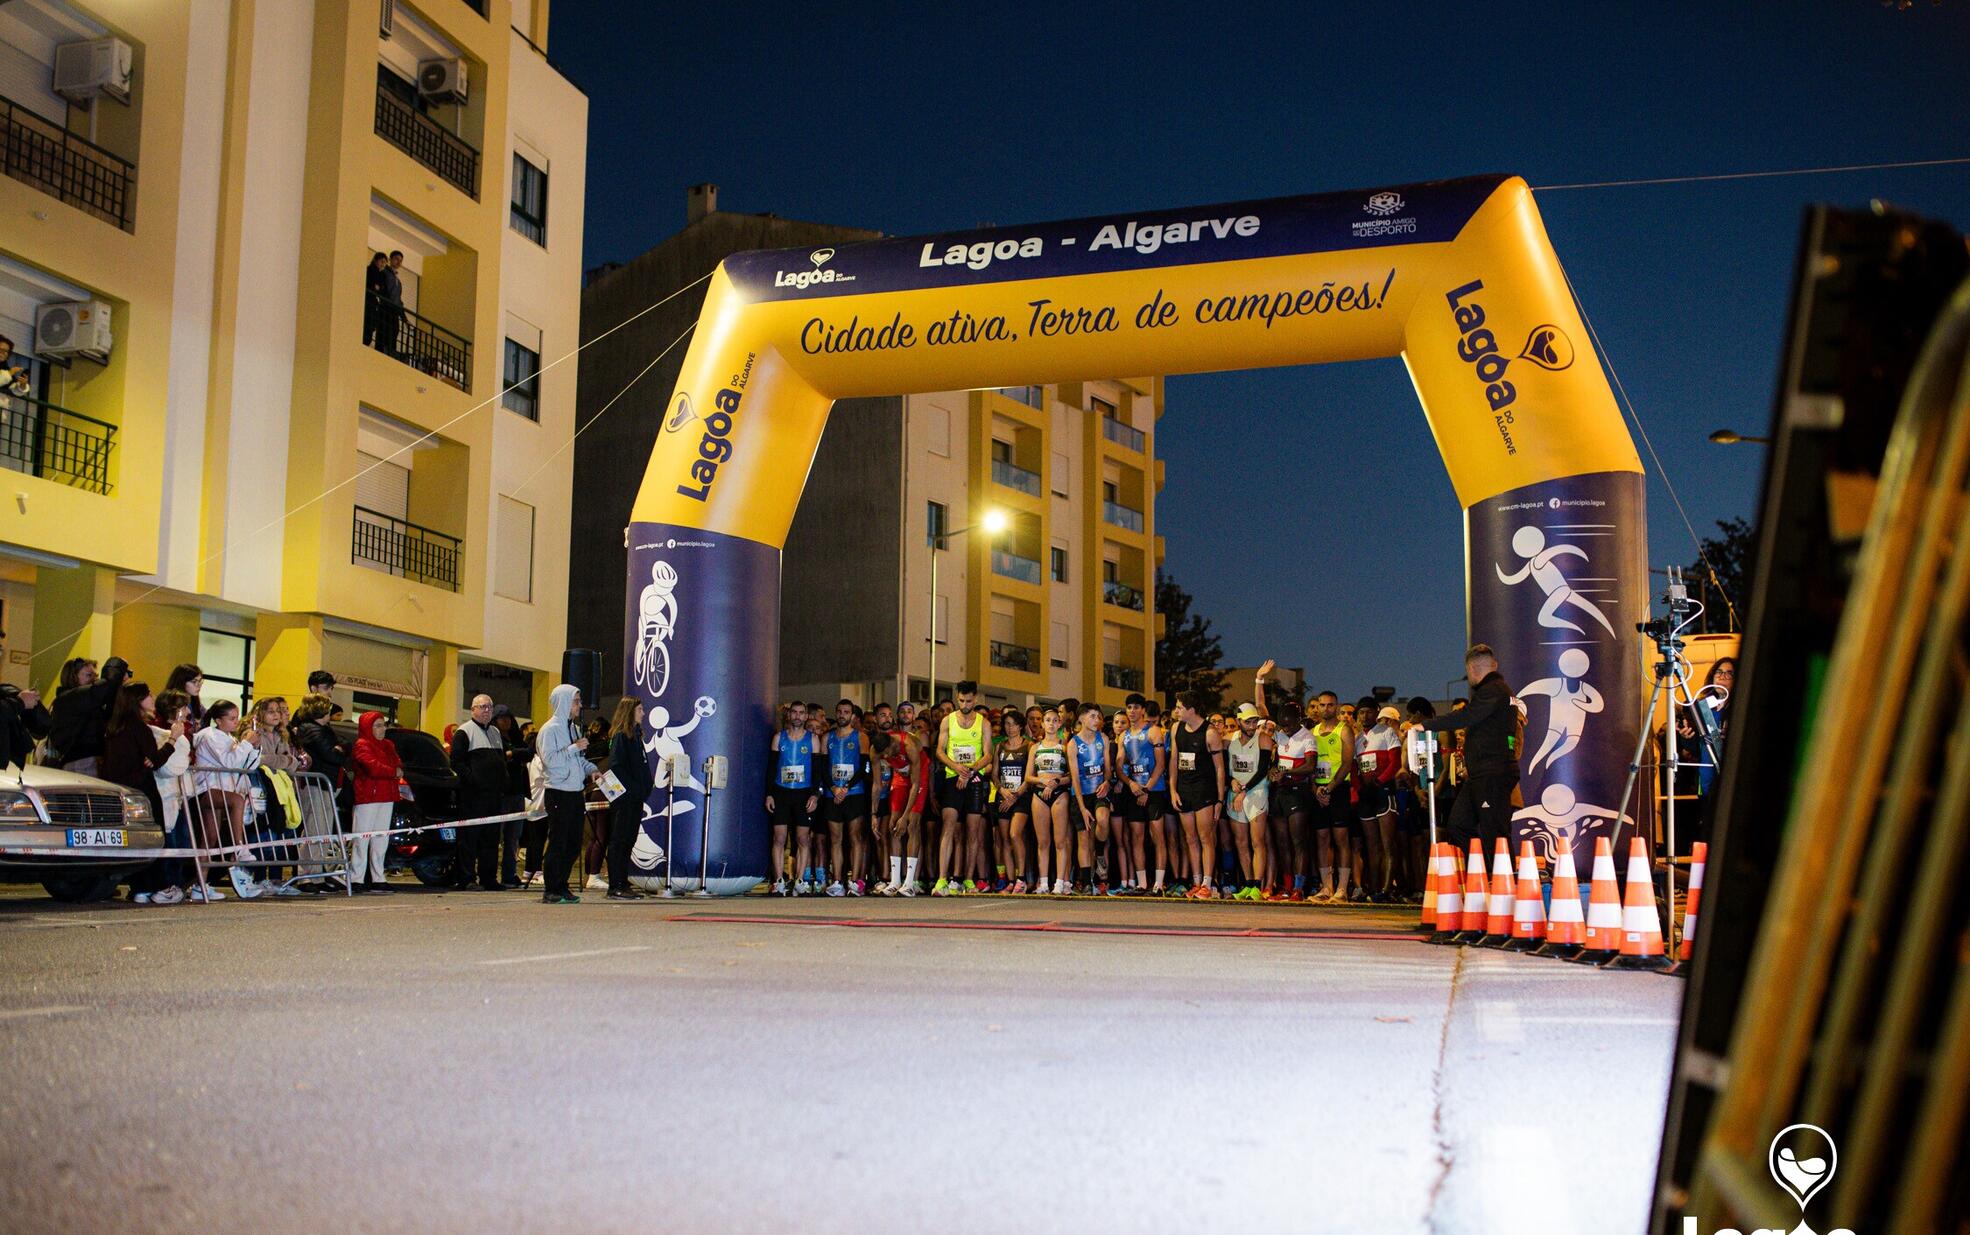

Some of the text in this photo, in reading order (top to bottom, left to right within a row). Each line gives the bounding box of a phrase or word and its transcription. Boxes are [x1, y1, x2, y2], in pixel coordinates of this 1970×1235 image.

[919, 215, 1261, 271] Lagoa - Algarve
[1360, 223, 1417, 237] DESPORTO
[775, 268, 836, 290] Lagoa
[800, 267, 1396, 355] Cidade ativa, Terra de campeões!
[1445, 279, 1517, 412] Lagoa
[739, 352, 756, 389] ALGARVE
[1494, 415, 1517, 456] ALGARVE
[1503, 410, 1514, 424] DO
[676, 388, 743, 503] Lagoa
